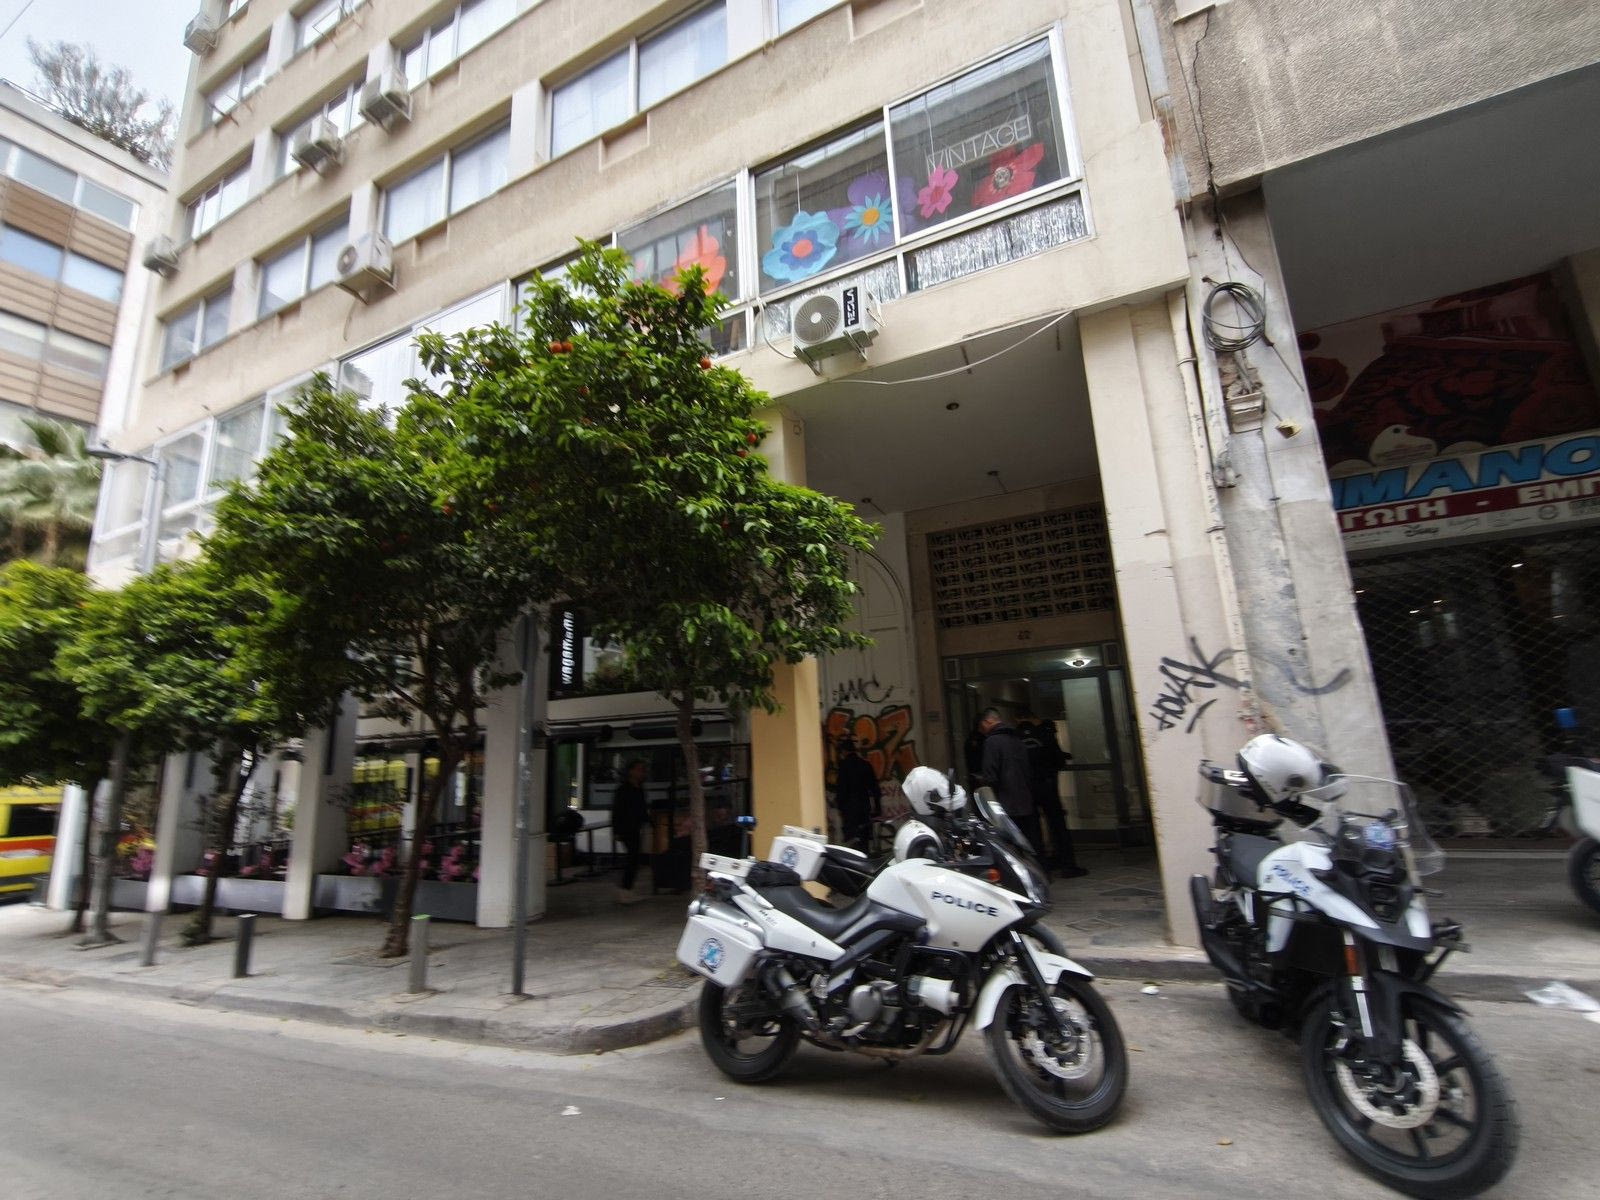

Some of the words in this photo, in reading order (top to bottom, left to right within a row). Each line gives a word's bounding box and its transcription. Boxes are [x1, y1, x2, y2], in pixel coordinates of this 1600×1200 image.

[927, 115, 1032, 173] VINTAGE
[846, 289, 856, 326] TESLA
[931, 891, 999, 918] POLICE
